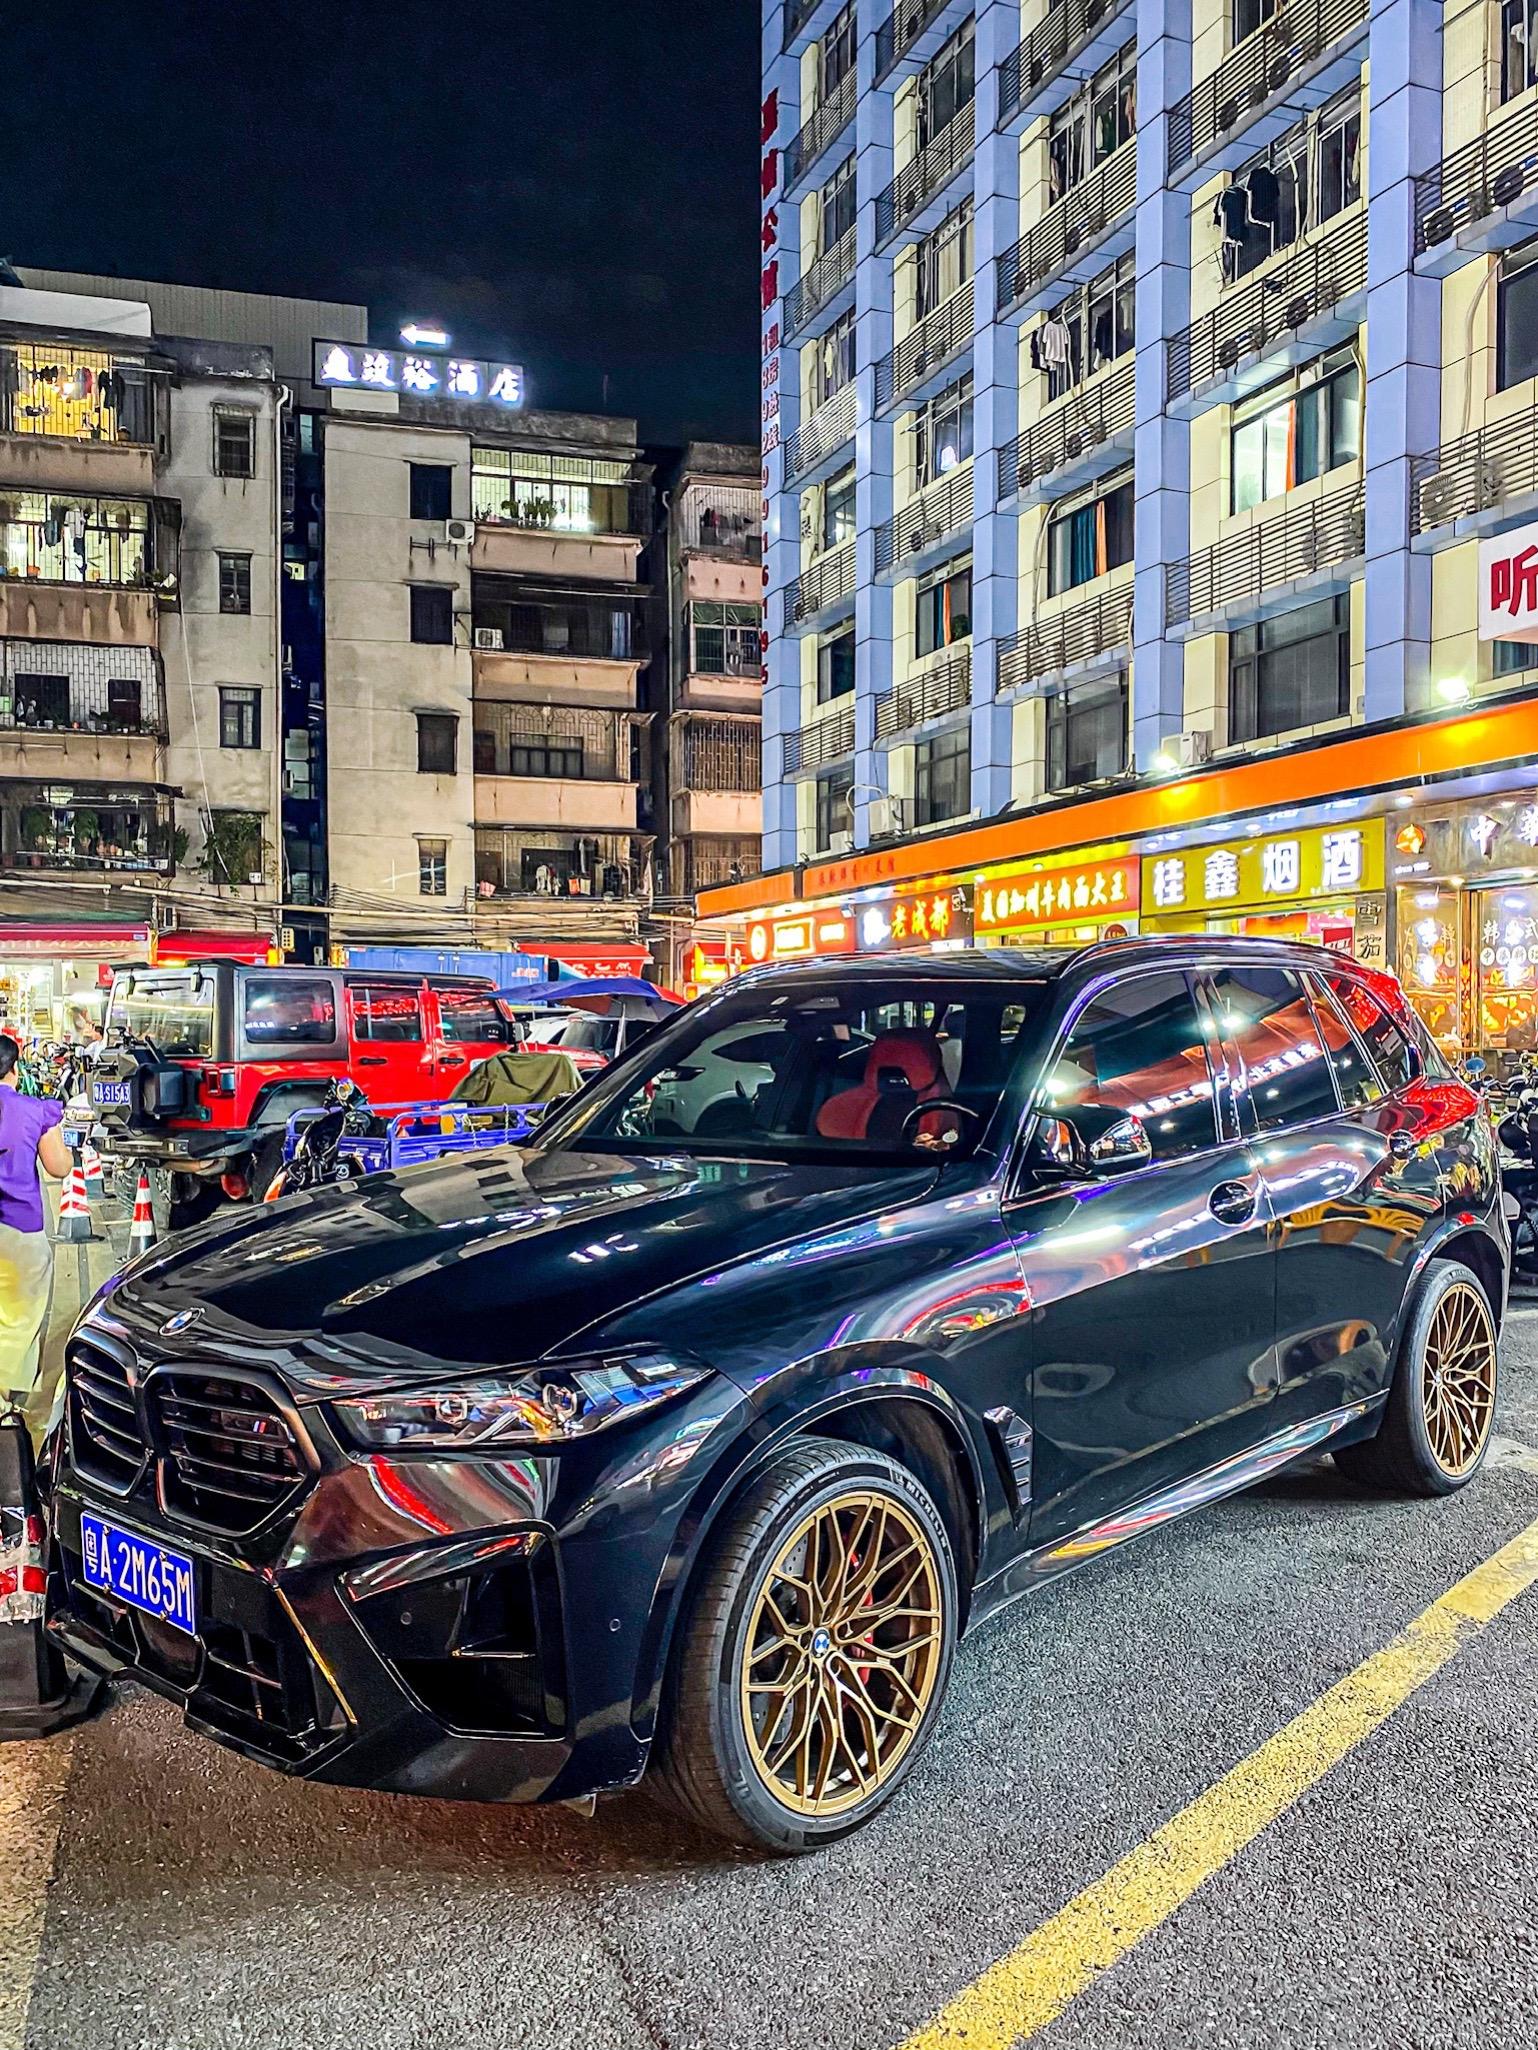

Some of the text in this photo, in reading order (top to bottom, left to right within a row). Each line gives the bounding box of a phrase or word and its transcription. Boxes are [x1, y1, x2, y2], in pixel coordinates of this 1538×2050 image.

[1491, 545, 1538, 616] 听
[1153, 832, 1363, 906] 桂鑫烟酒
[891, 896, 949, 939] 老成都
[1357, 901, 1382, 958] 雪茄
[85, 1525, 192, 1622] 粤A·2M65M
